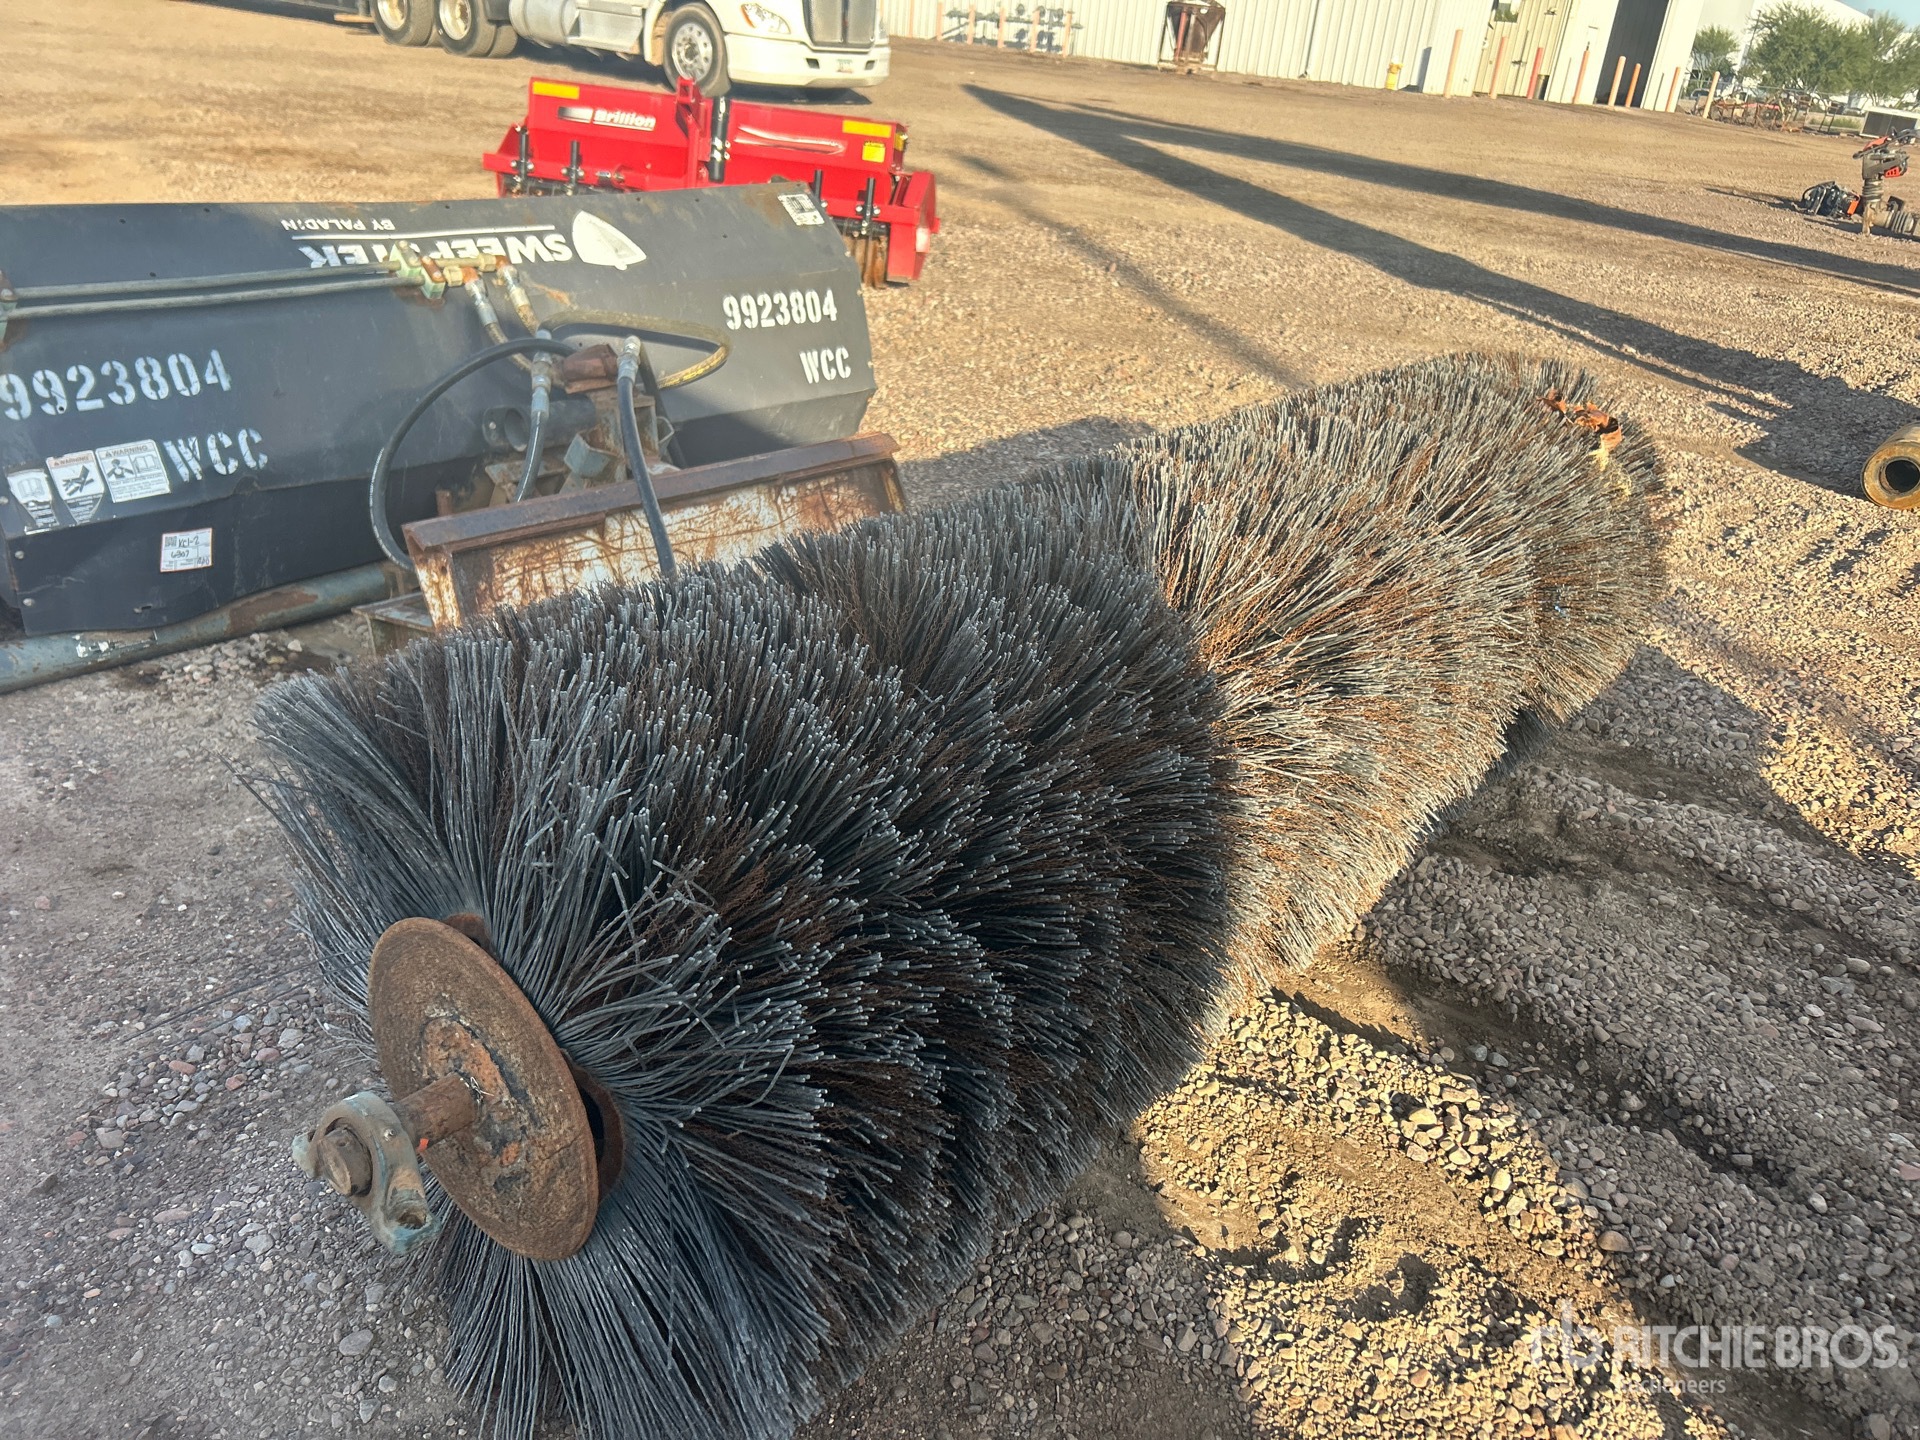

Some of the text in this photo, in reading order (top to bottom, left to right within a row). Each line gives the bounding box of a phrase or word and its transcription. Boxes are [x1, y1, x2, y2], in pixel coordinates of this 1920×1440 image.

[593, 107, 656, 128] Brillion
[280, 218, 396, 230] BY PALADIN
[722, 287, 838, 330] 9923804
[799, 346, 852, 384] WCC
[0, 349, 231, 421] 9923804
[59, 455, 89, 466] WARNING
[112, 445, 148, 456] WARNING
[163, 428, 268, 483] WCC
